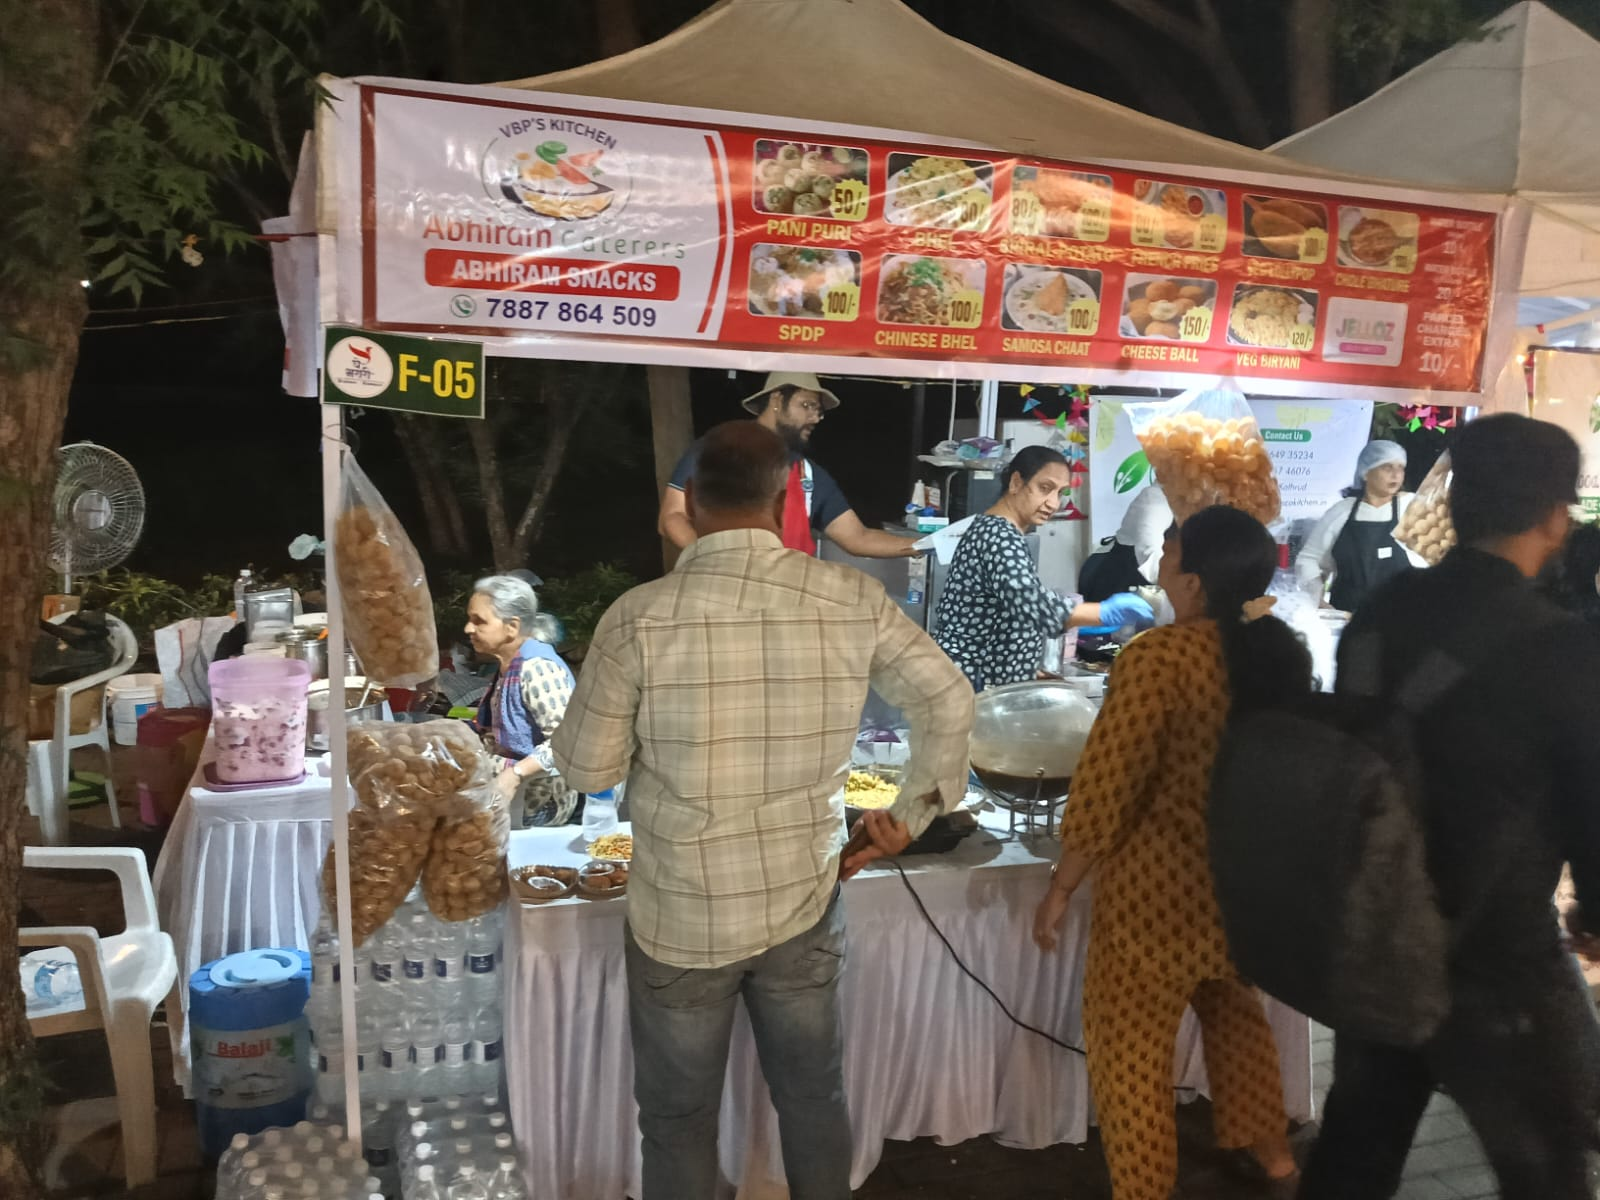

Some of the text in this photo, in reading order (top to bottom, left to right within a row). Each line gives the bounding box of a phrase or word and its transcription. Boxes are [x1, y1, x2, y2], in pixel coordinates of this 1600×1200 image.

[499, 118, 619, 151] VBP'S KITCHEN
[767, 219, 854, 241] PANI PURI
[452, 258, 657, 293] ABHIRAM SNACKS
[487, 298, 657, 328] 7887 864 509
[827, 291, 856, 317] 100/-
[951, 300, 982, 323] 100/-
[1069, 308, 1099, 331] 100/-
[1183, 317, 1210, 337] 150/-
[778, 324, 826, 342] SPDP
[874, 330, 978, 351] CHINESE BHEL
[1001, 337, 1092, 357] SAMOSA CHAAT
[1121, 345, 1200, 363] CHEESE BALL
[1236, 352, 1301, 370] VEG BIRYANI
[398, 353, 476, 400] F-05
[1265, 430, 1304, 441] Contact Us
[1287, 450, 1315, 460] 35234
[217, 1038, 273, 1059] Balaji
